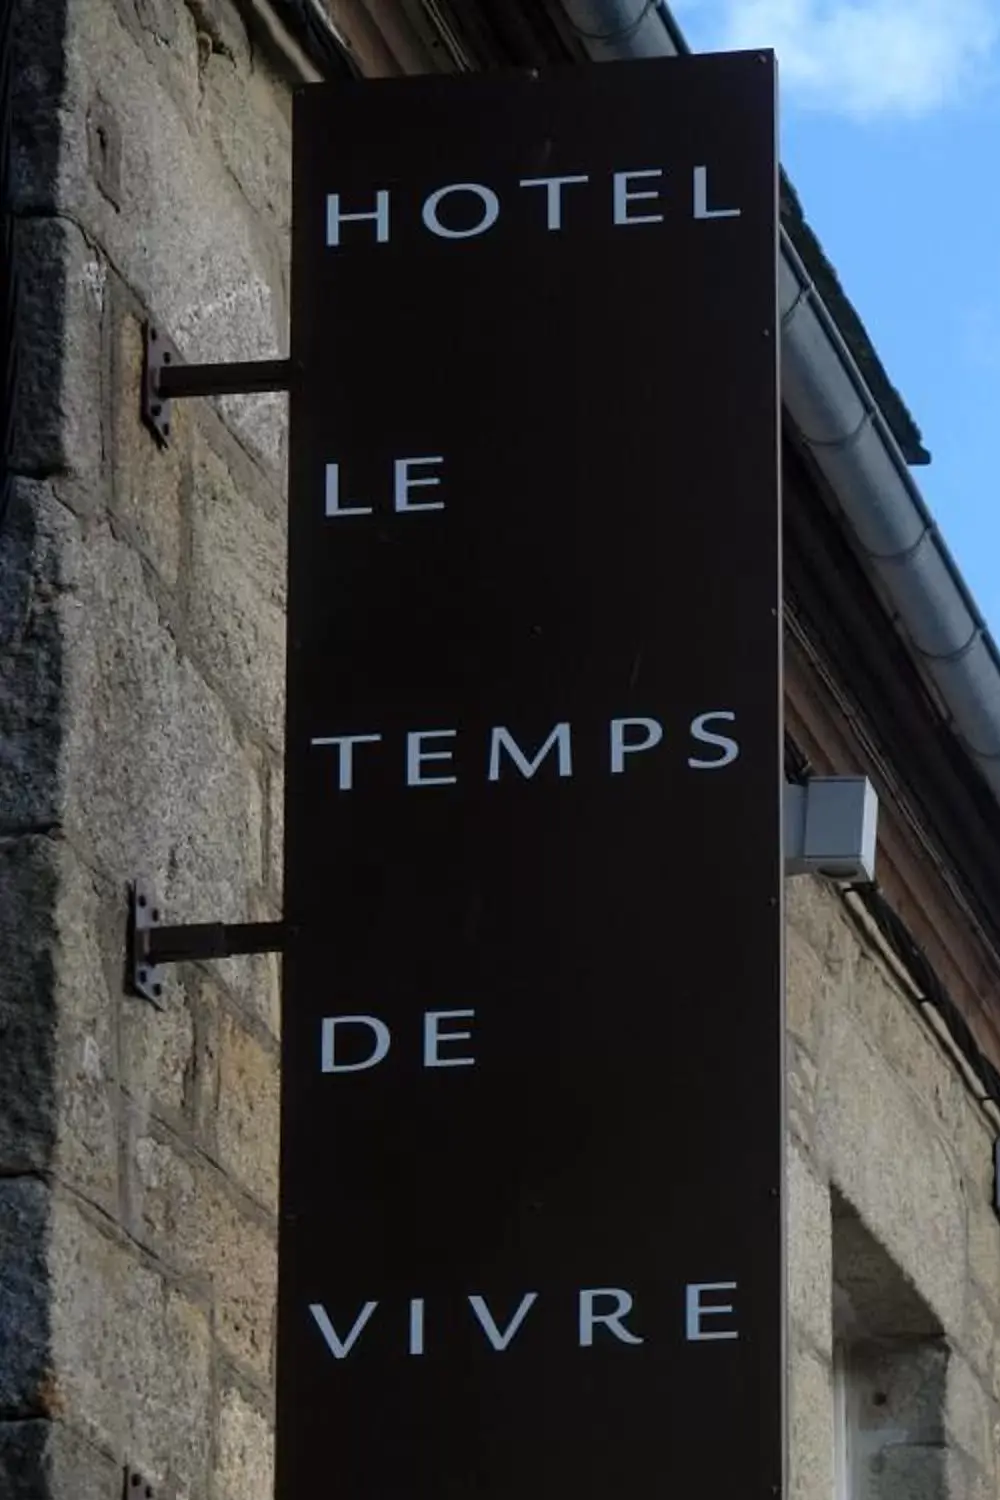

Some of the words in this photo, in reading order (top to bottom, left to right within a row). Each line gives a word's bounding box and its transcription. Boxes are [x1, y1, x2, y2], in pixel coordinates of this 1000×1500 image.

[324, 165, 741, 246] HOTEL
[324, 457, 446, 517] LE
[312, 711, 739, 790] TEMPS
[320, 1009, 476, 1073] DE
[309, 1282, 738, 1359] VIVRE
